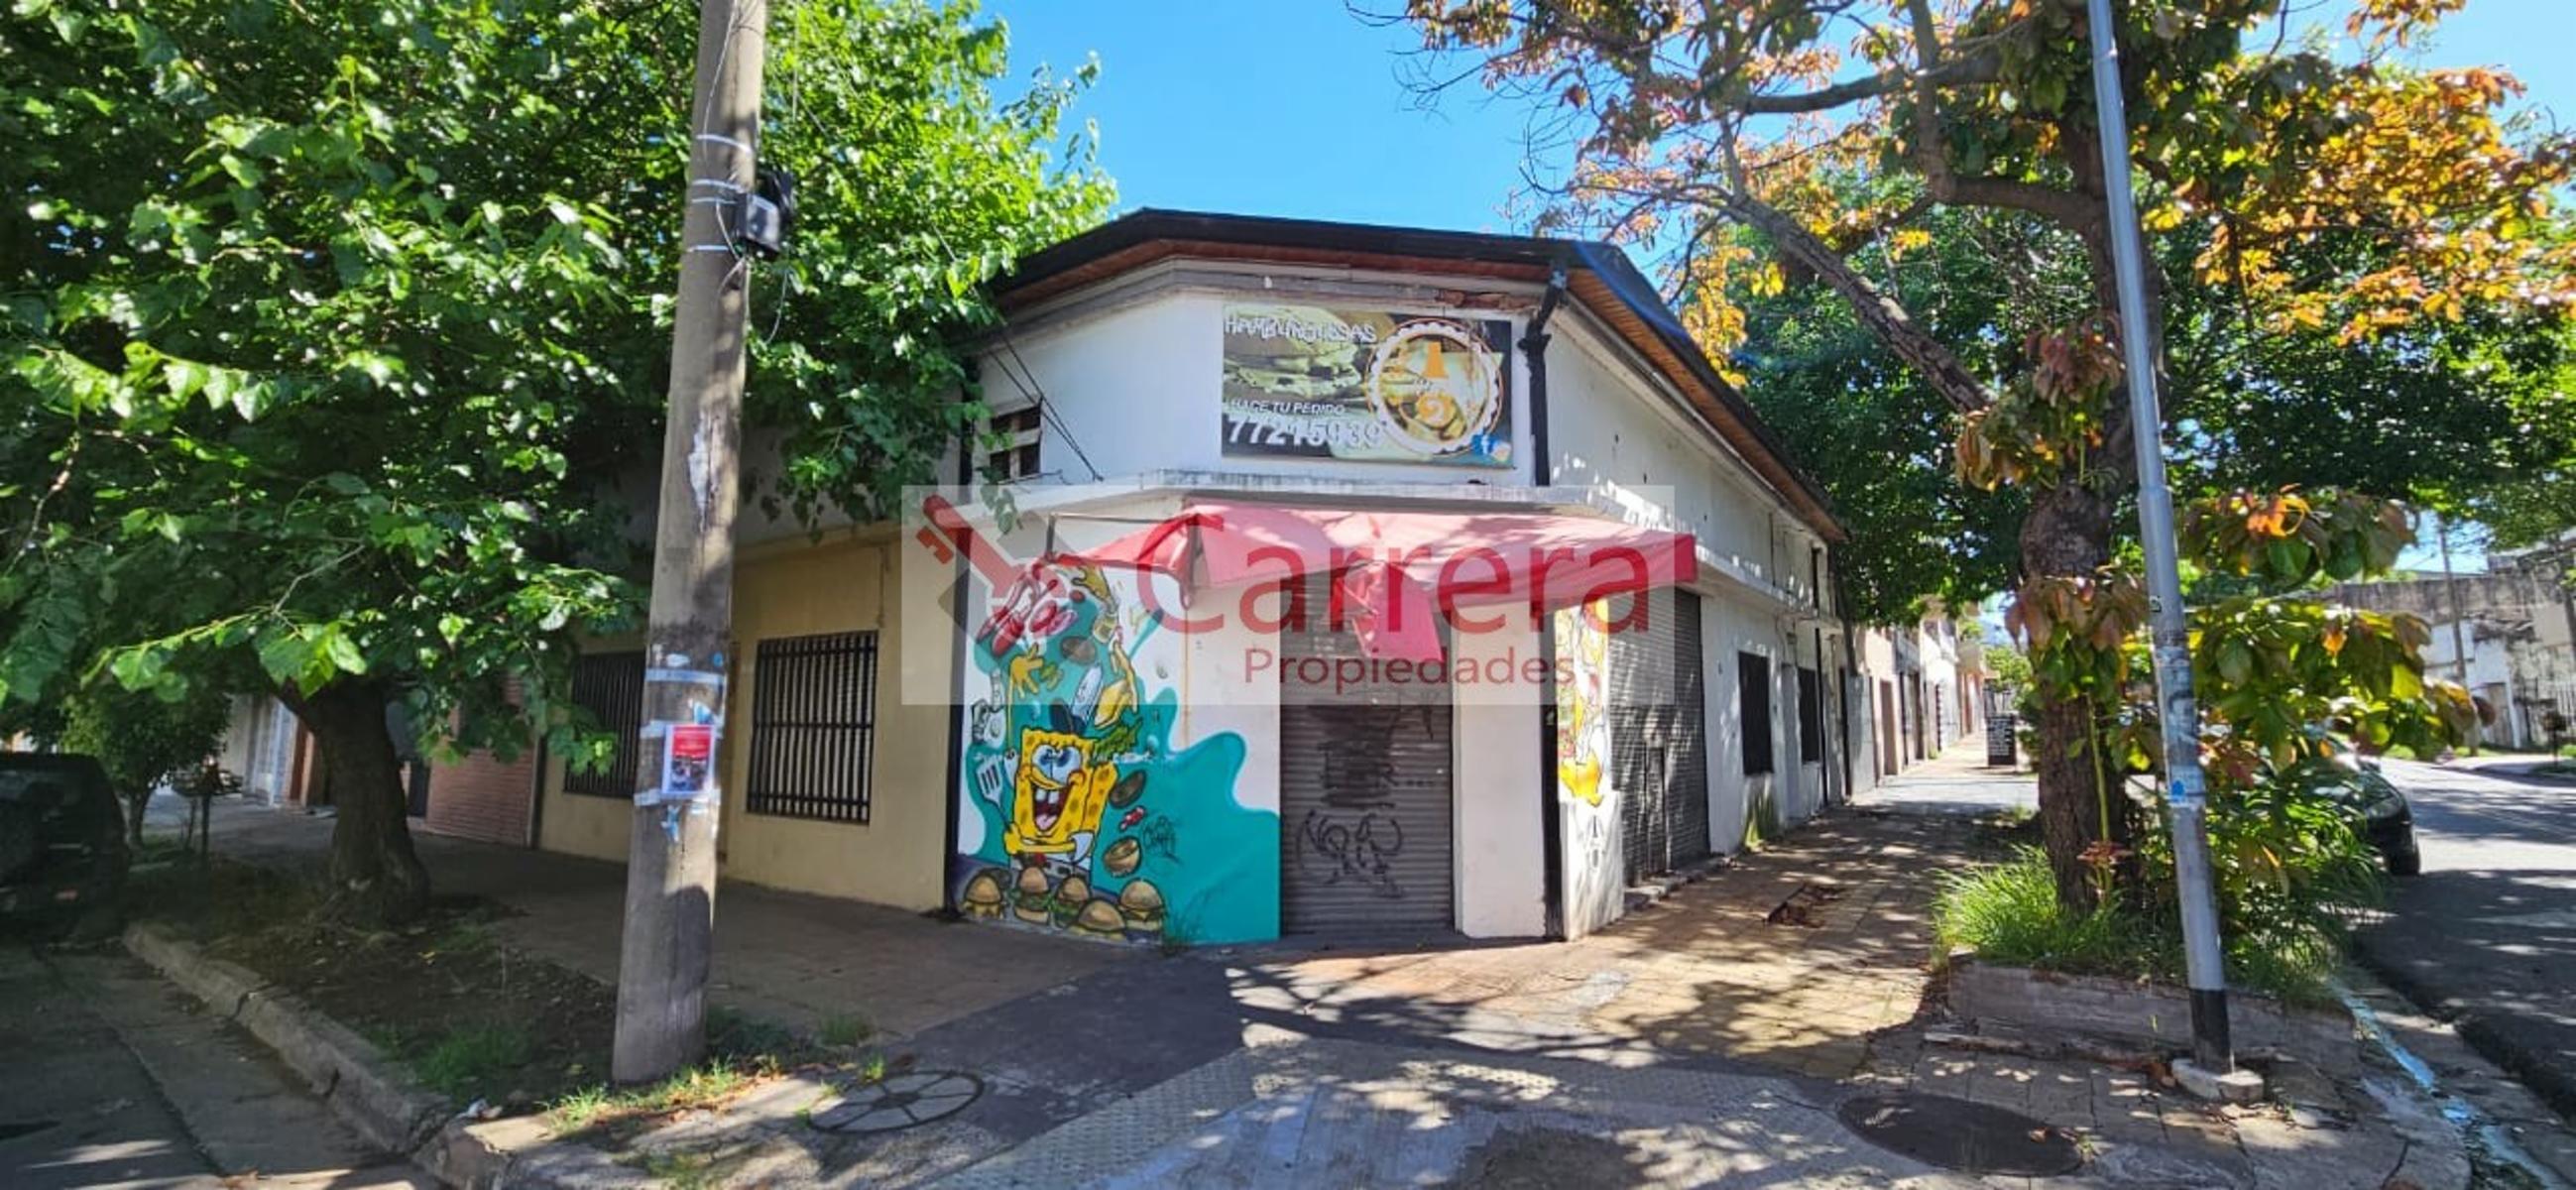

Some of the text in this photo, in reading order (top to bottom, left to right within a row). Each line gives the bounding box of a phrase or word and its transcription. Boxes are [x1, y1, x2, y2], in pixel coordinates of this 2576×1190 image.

[1230, 398, 1346, 416] HACE TU PEDIDO
